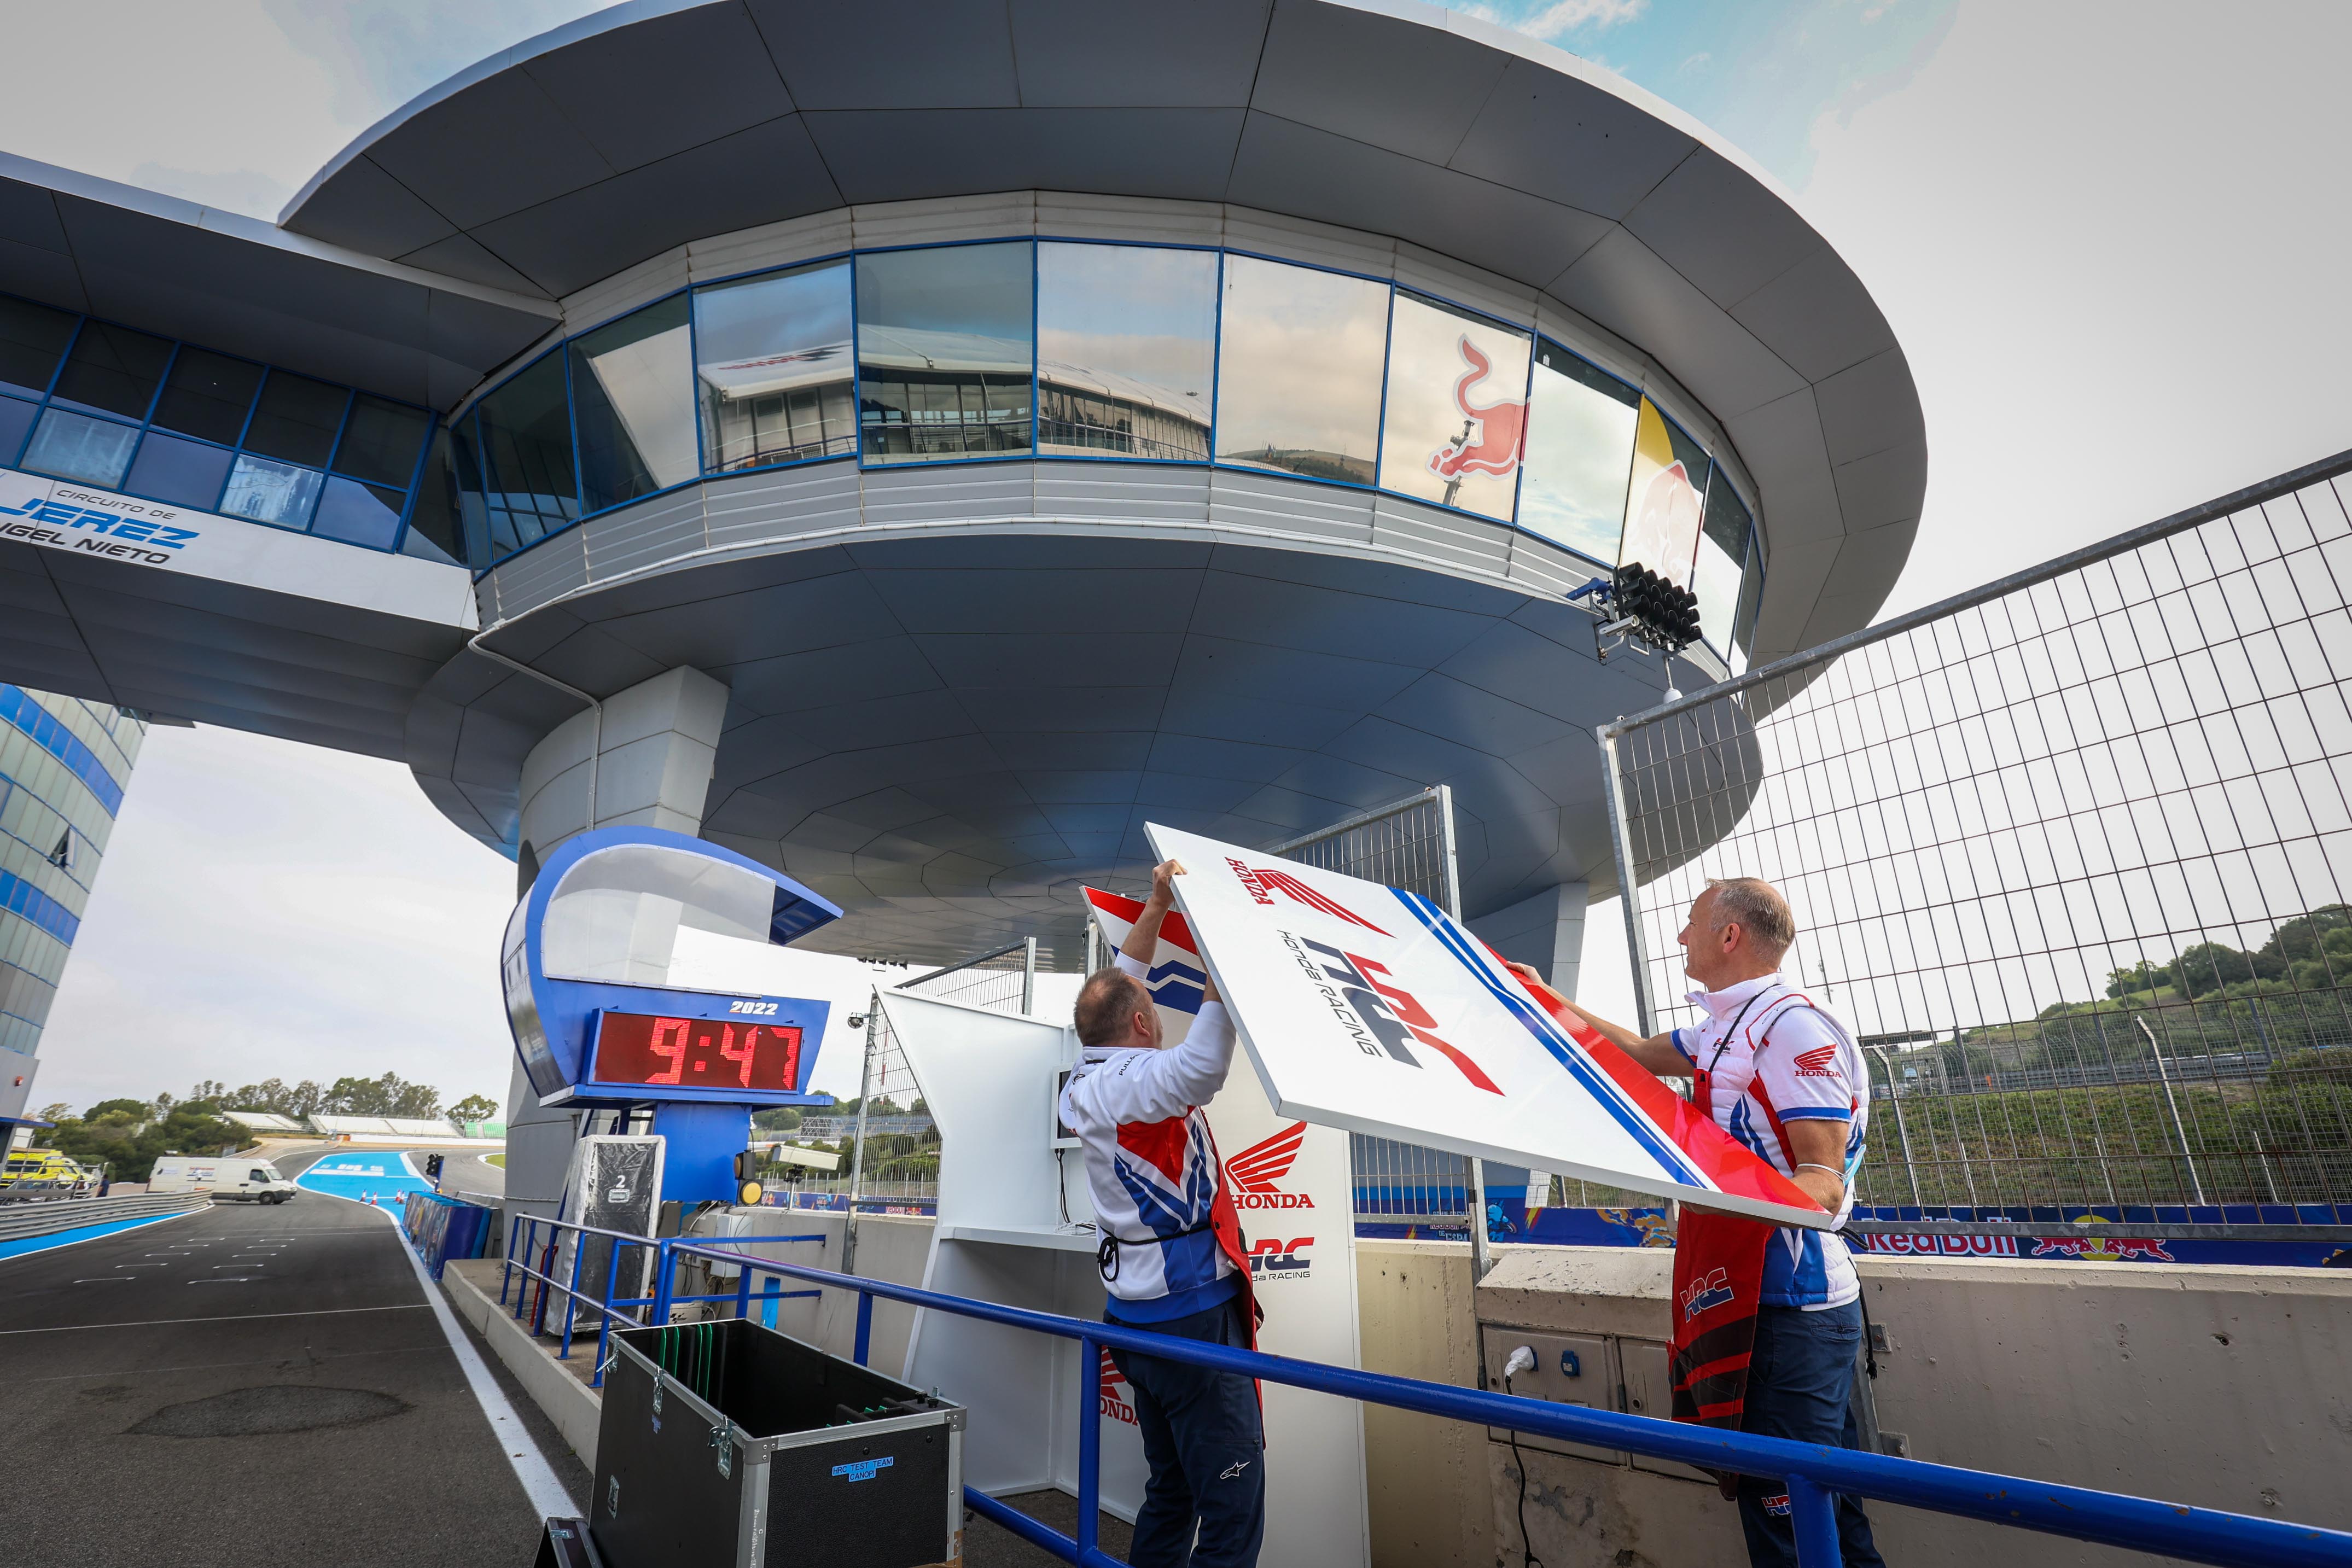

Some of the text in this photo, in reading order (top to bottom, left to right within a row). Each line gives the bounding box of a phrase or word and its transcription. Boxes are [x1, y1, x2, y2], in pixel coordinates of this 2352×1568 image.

[56, 489, 177, 520] CIRCUITO DE
[73, 538, 170, 564] NIETO
[1225, 856, 1275, 905] HONDA
[1277, 929, 1383, 1058] Honda RACING
[729, 1001, 778, 1015] 2022
[1299, 936, 1507, 1097] HRC
[645, 1018, 800, 1089] 9:47
[616, 1174, 626, 1188] 2
[1445, 1233, 1471, 1241] ESPA
[1269, 1271, 1311, 1280] RACING
[1680, 1267, 1735, 1324] HRC
[833, 1458, 893, 1474] HRC TEST TEAM
[849, 1470, 875, 1480] CANOPI
[1761, 1495, 1790, 1516] HR
